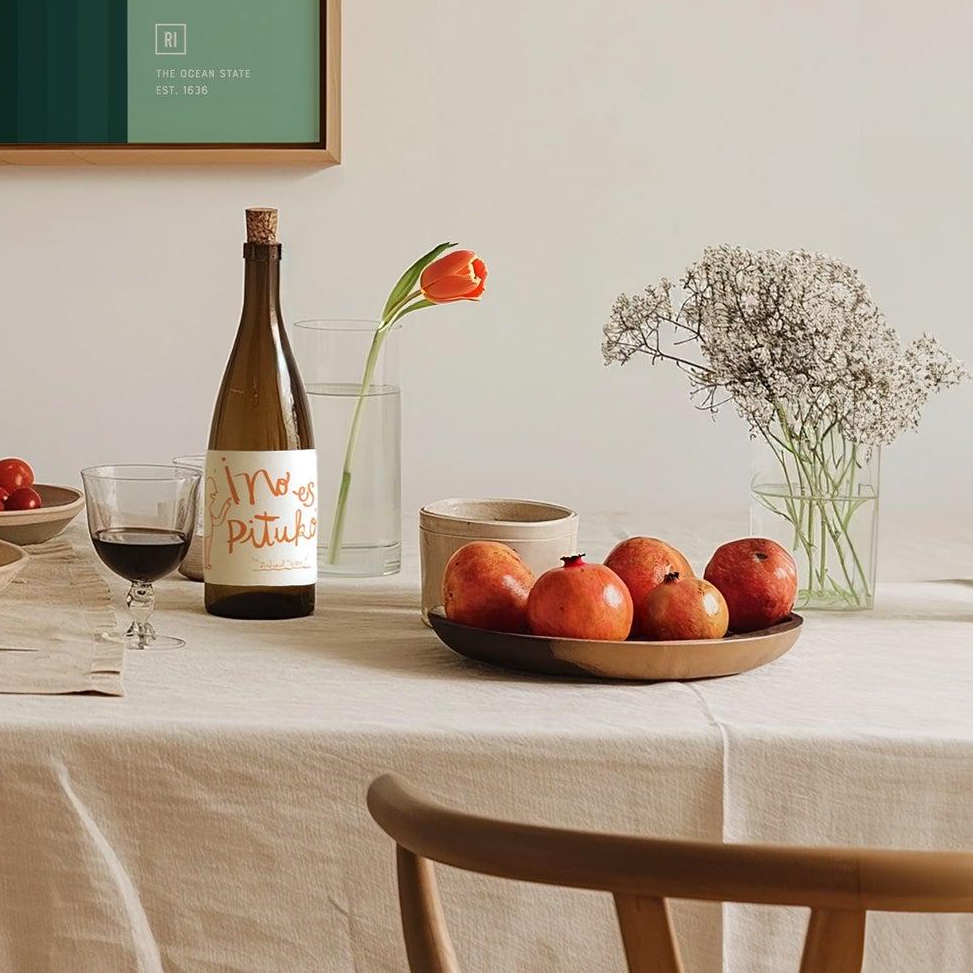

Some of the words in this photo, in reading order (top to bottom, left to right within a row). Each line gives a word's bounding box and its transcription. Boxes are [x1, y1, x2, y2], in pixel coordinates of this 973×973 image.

[164, 31, 177, 48] RI
[156, 69, 176, 78] THE
[180, 69, 215, 78] OCEAN
[220, 69, 251, 78] STATE
[156, 85, 179, 95] EST.
[183, 85, 209, 95] 1636
[292, 481, 315, 507] es
